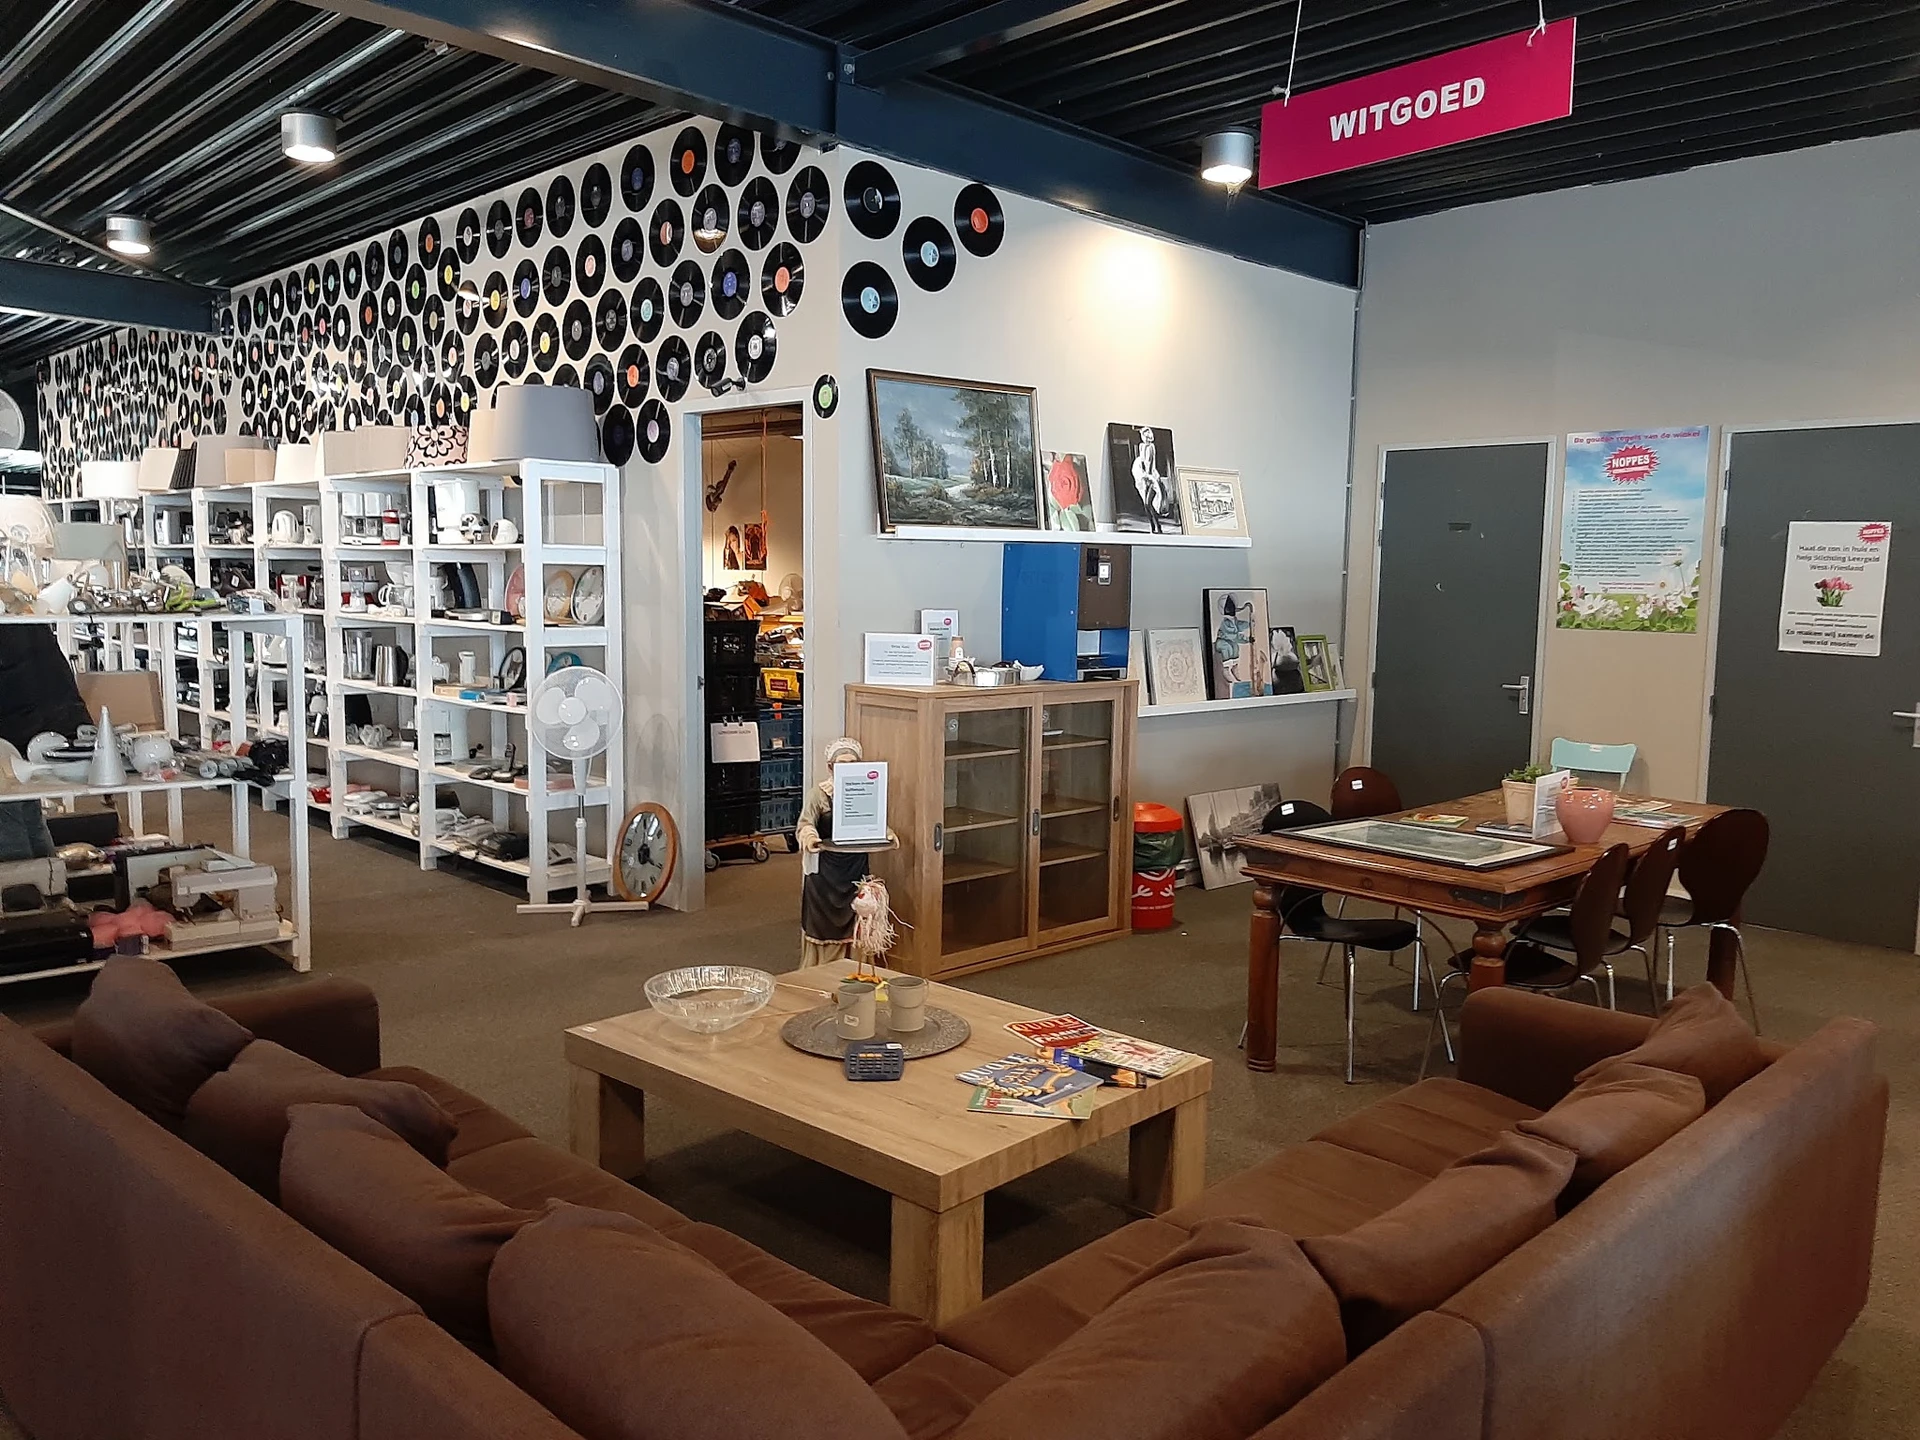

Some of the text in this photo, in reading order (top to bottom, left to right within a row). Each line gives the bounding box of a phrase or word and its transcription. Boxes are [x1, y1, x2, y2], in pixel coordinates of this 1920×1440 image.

[1329, 77, 1486, 142] WITGOED
[1813, 554, 1847, 563] Stichting
[1847, 555, 1880, 563] Leergeld
[1011, 1016, 1077, 1032] QUOTE
